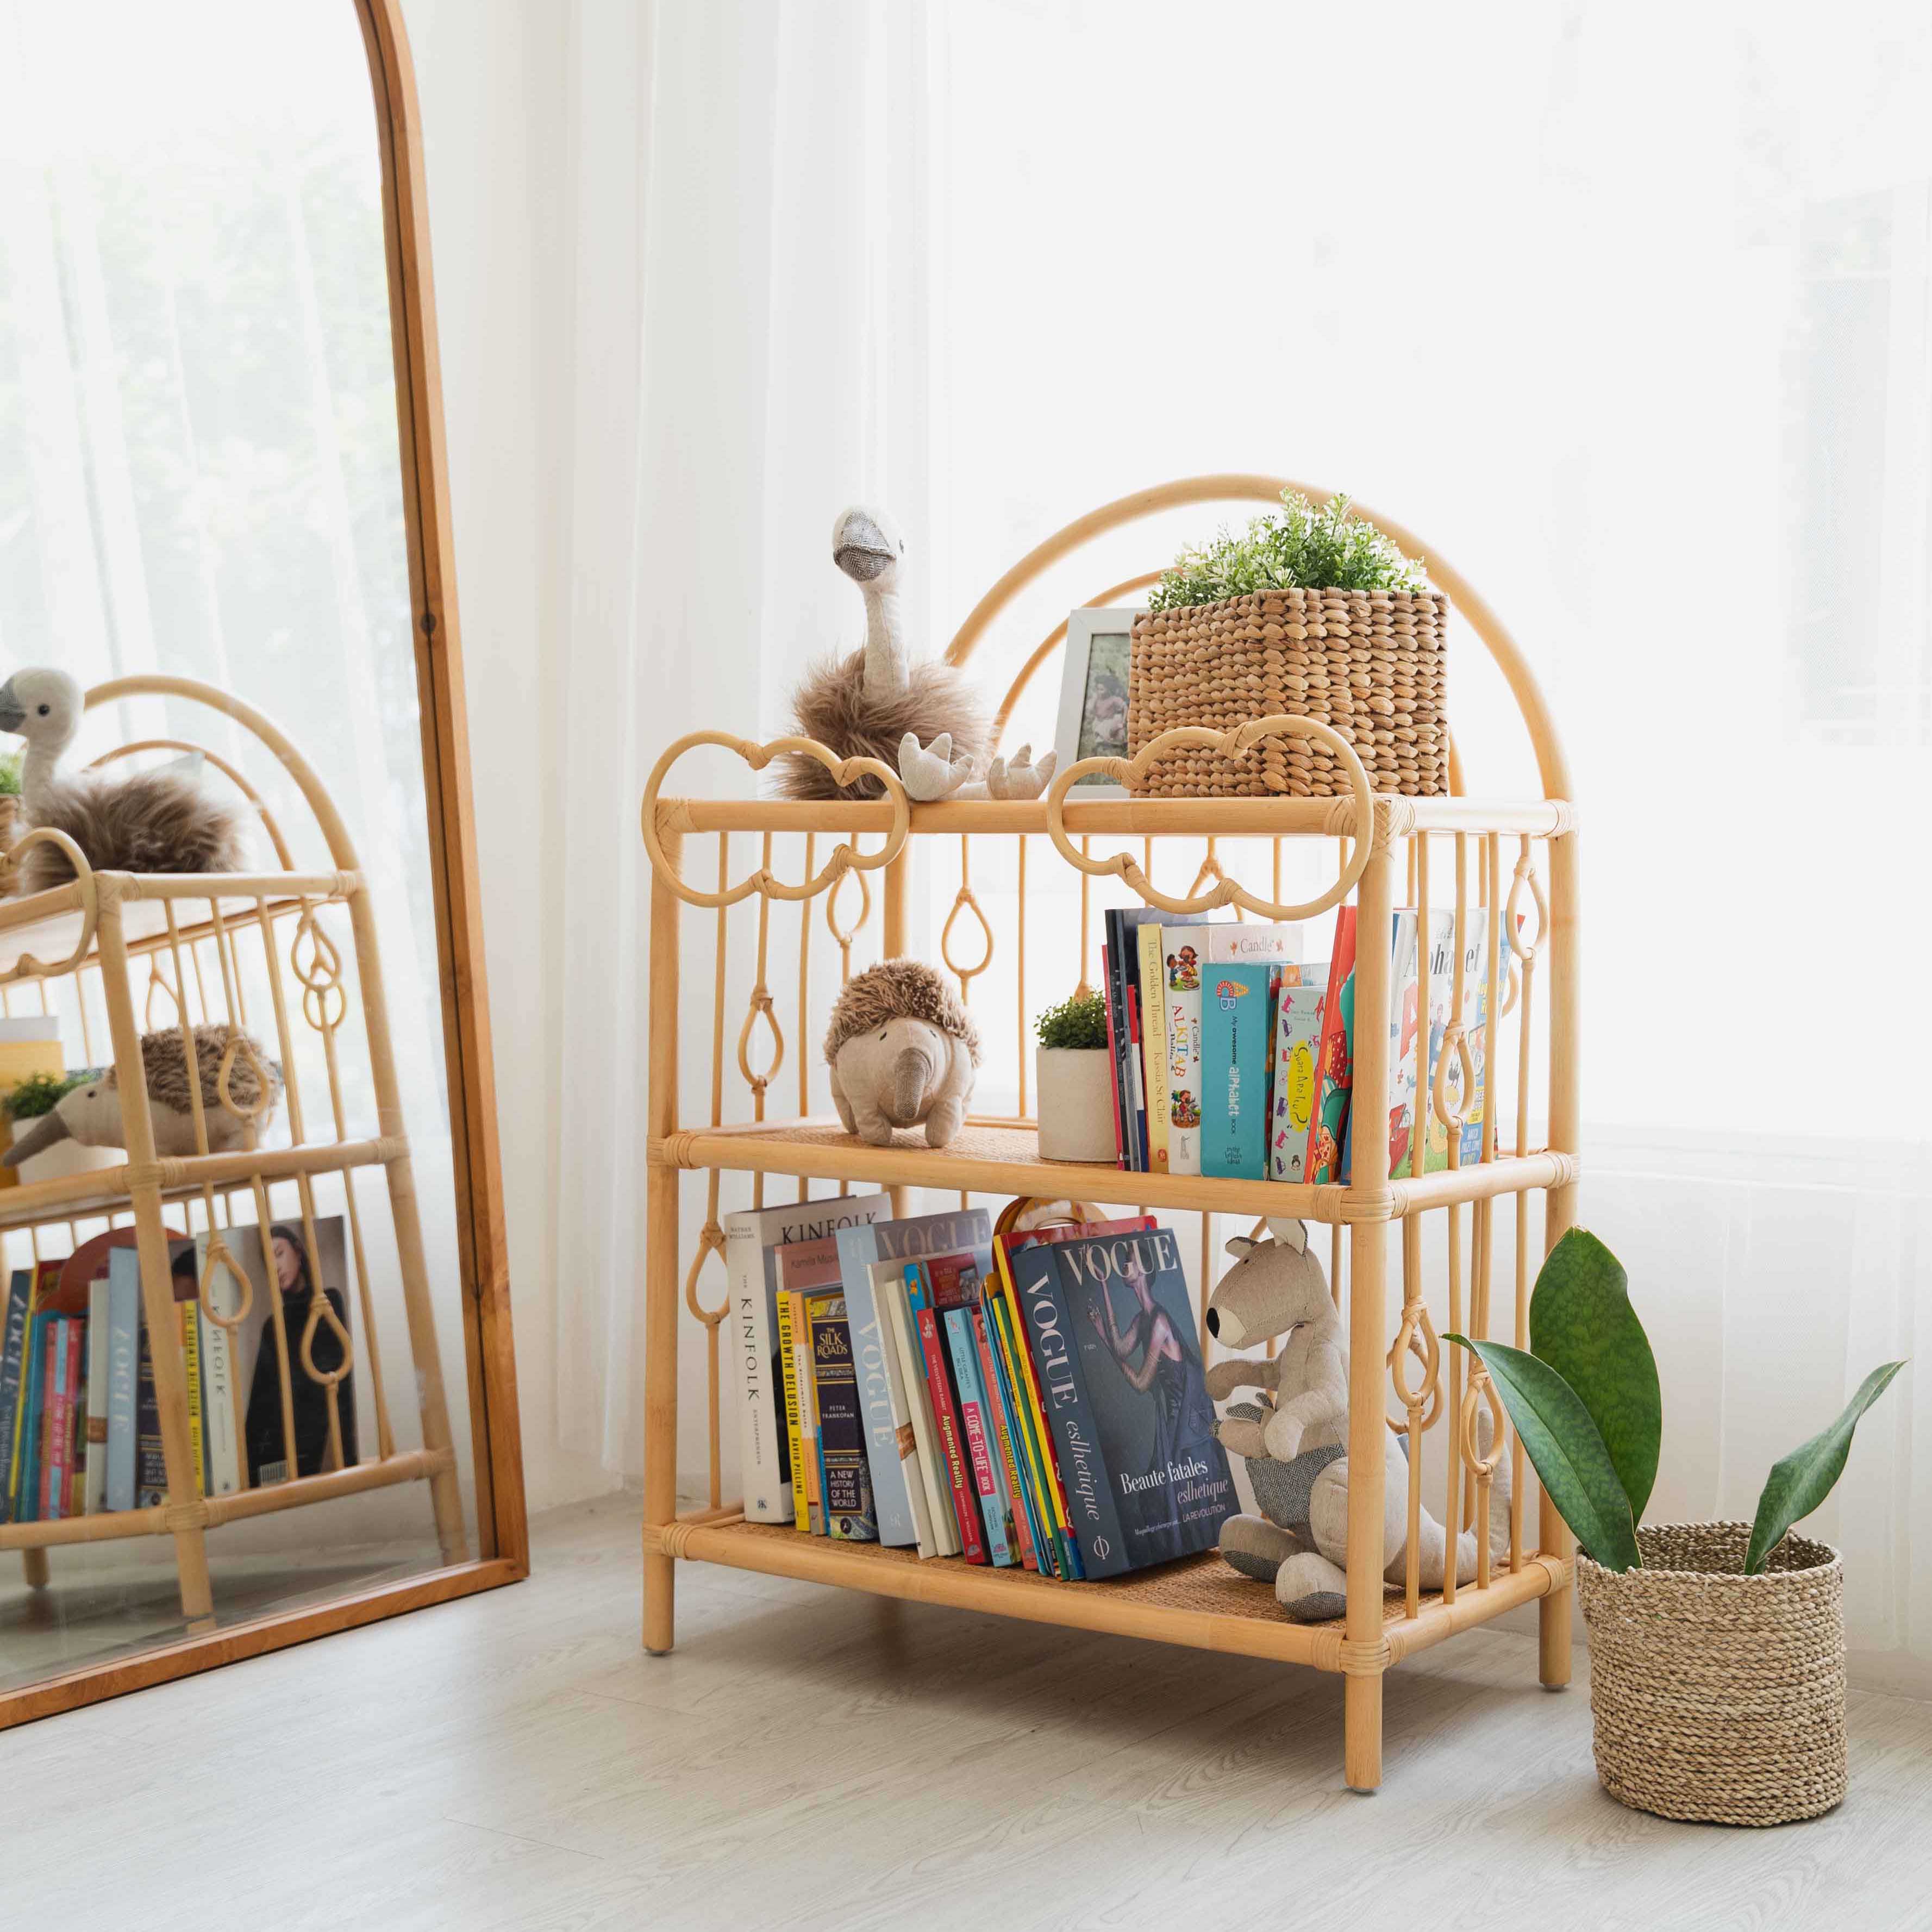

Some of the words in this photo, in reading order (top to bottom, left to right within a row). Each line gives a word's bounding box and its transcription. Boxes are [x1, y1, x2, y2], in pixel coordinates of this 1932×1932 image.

[1147, 939, 1157, 956] The
[1241, 936, 1273, 953] Candle
[1403, 943, 1481, 977] Ahaet
[1149, 961, 1159, 999] Golden
[1151, 1002, 1162, 1036] Thread
[1230, 1015, 1238, 1026] My
[1172, 1005, 1189, 1077] ALKITAB
[1191, 1026, 1200, 1053] Candle
[1154, 1052, 1164, 1082] Kassia
[1156, 1098, 1166, 1124] Clair
[878, 1215, 991, 1259] VOGUE
[1061, 1235, 1178, 1286] VOGUE
[779, 1300, 791, 1320] THE
[741, 1298, 760, 1400] KINFOLK
[781, 1324, 794, 1368] GROWTH
[817, 1344, 848, 1359] ROADS
[819, 1332, 843, 1346] SILK
[1026, 1272, 1078, 1410] VOGUE
[785, 1374, 799, 1426] DELUSION
[858, 1321, 895, 1447] VOGUE
[791, 1437, 801, 1460] DAVID
[942, 1415, 959, 1460] Augmented
[951, 1460, 964, 1489] Reality
[966, 1414, 988, 1471] COME-TO-LIFE
[980, 1475, 991, 1491] BOOK
[1000, 1424, 1017, 1469] Augmented
[1009, 1469, 1022, 1499] Reality
[795, 1463, 803, 1495] PILLING
[830, 1480, 855, 1488] HISTORY
[837, 1470, 854, 1479] NEW
[1120, 1470, 1166, 1495] Beaute
[1167, 1456, 1209, 1483] fatales
[831, 1490, 841, 1498] OF
[842, 1489, 856, 1498] THE
[832, 1498, 857, 1508] WORLD
[1182, 1513, 1191, 1522] LA
[1191, 1503, 1227, 1520] REVOLUTION
